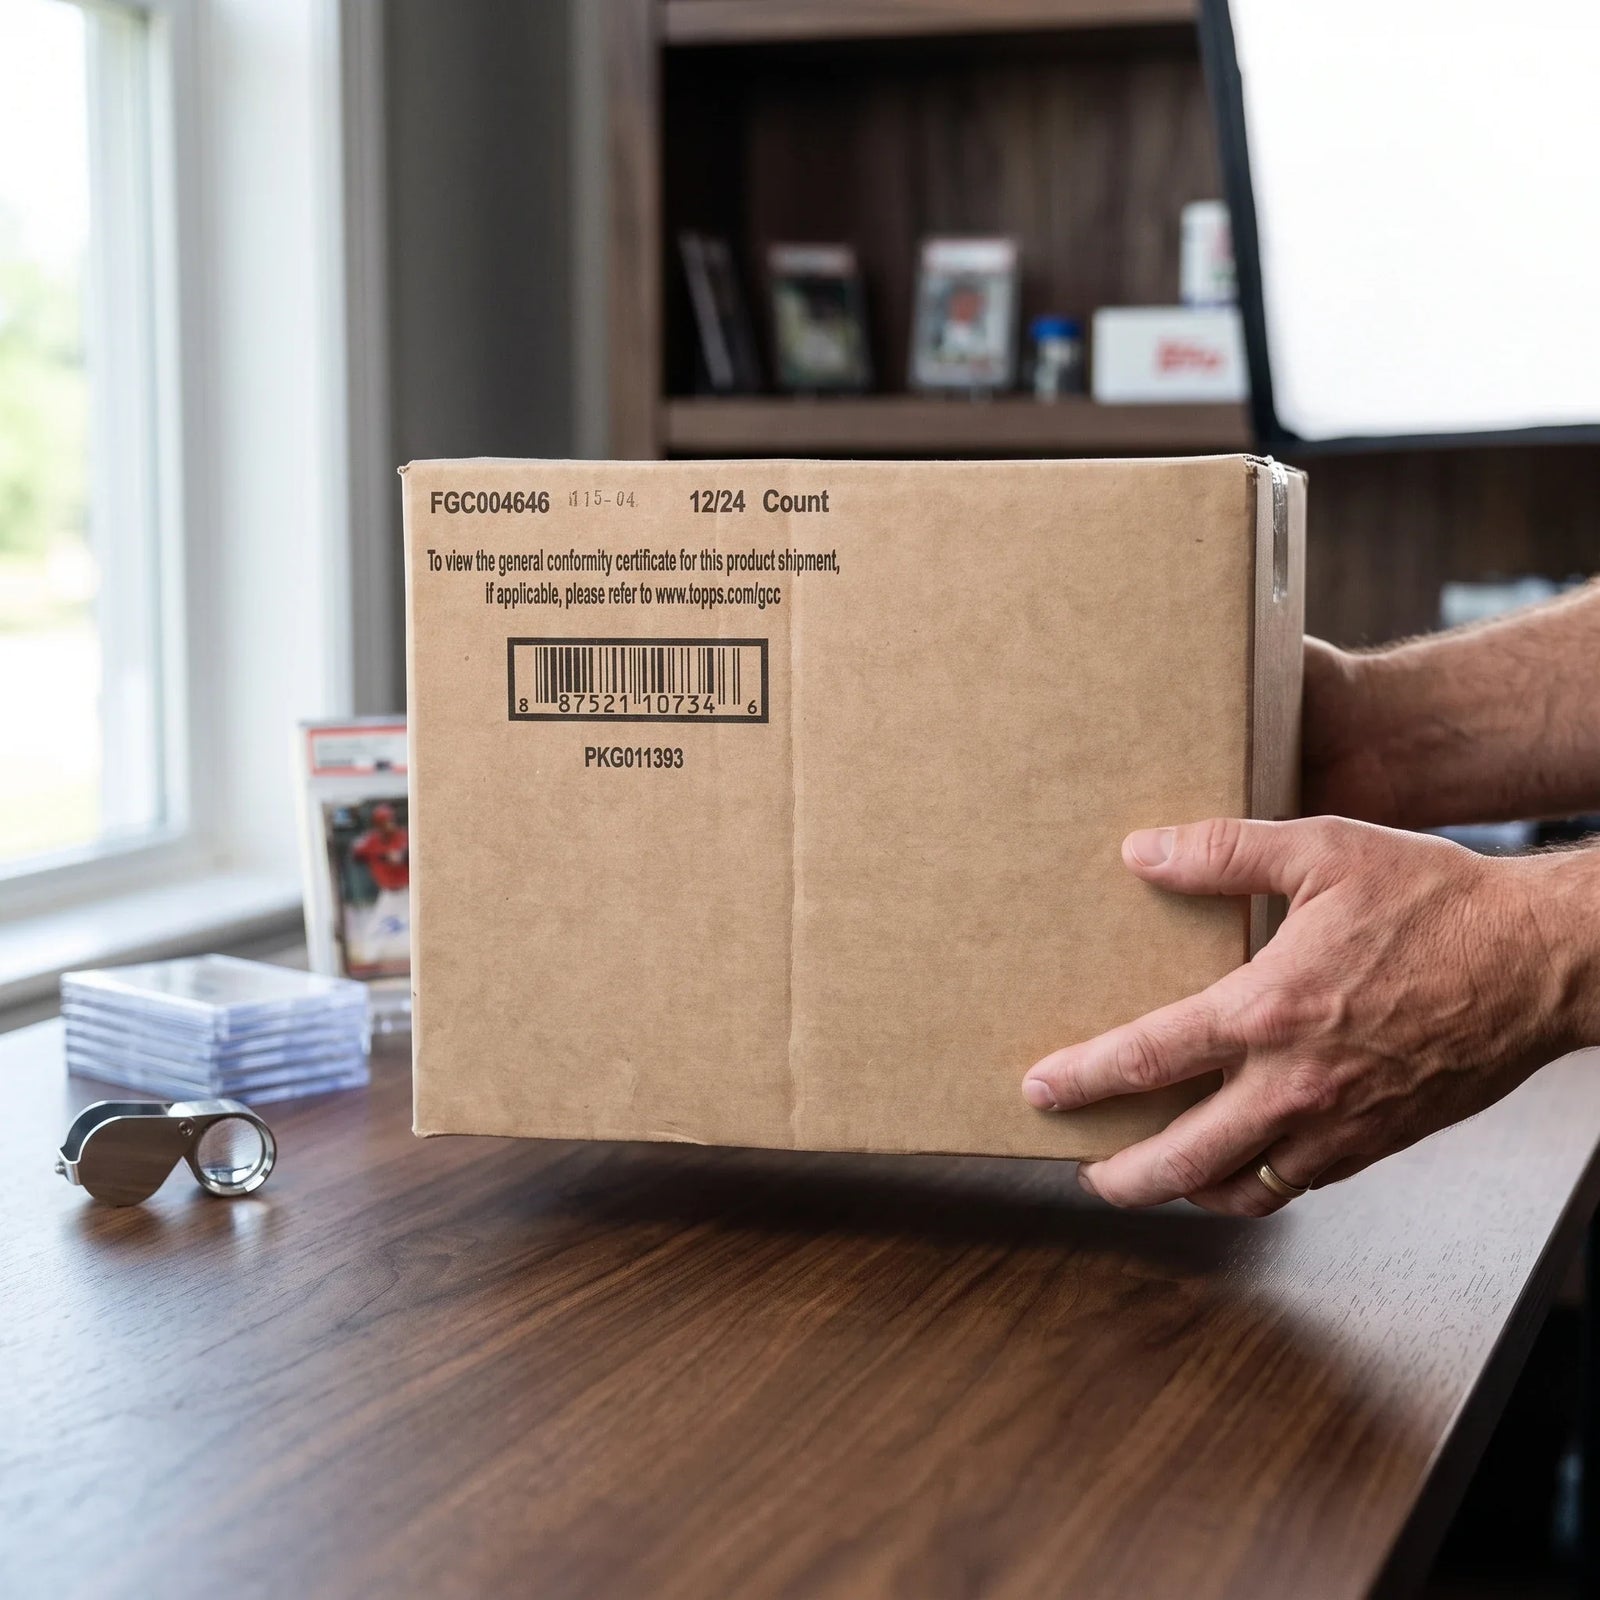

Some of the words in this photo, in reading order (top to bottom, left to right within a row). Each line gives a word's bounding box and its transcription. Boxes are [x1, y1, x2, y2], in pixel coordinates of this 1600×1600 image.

[430, 491, 550, 514] FGC004646
[689, 489, 746, 514] 12/24
[762, 489, 830, 513] Count
[427, 550, 442, 571] To
[445, 550, 473, 571] view
[476, 549, 495, 571] the
[499, 549, 543, 576] general
[547, 549, 612, 576] conformity
[616, 549, 676, 571] certificate
[680, 549, 697, 571] for
[700, 549, 723, 571] this
[727, 549, 775, 576] product
[778, 549, 840, 576] shipment,
[485, 582, 495, 604] if
[497, 582, 562, 609] applicable,
[566, 582, 605, 609] please
[609, 582, 638, 604] refer
[640, 583, 653, 604] to
[656, 582, 781, 609] www.topps.com/gcc
[519, 698, 529, 713] 8
[558, 694, 629, 713] 87521
[642, 694, 716, 714] 10734
[747, 699, 758, 714] 6
[584, 746, 684, 769] PKG011393
